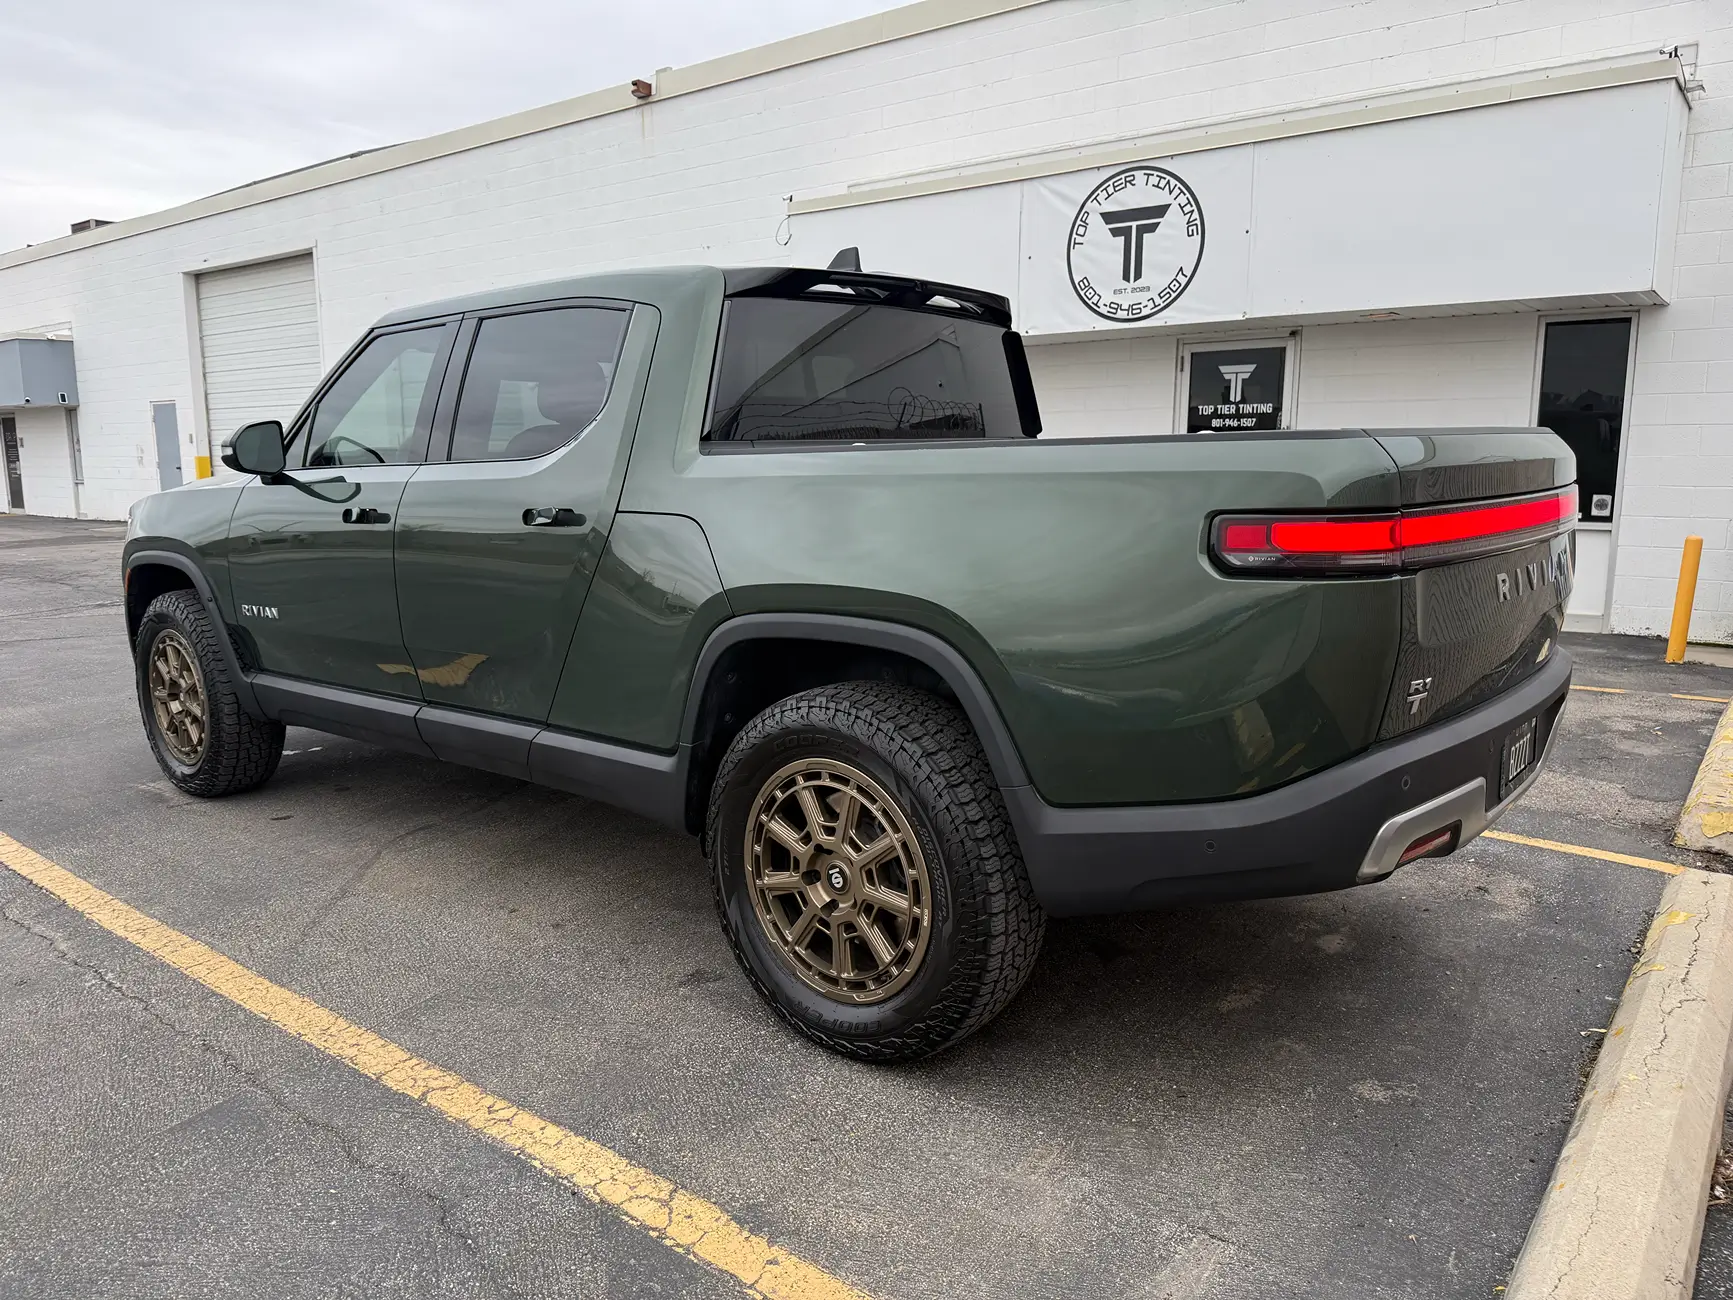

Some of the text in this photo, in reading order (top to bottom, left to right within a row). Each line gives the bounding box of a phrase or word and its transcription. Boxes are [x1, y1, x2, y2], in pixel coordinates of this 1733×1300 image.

[1072, 172, 1199, 250] TOP TIER TINTING
[1077, 266, 1188, 316] 801-946-1507
[1113, 285, 1151, 296] EST. 2023
[1198, 403, 1273, 415] TOP TIER TINTING
[1211, 418, 1257, 428] 801-946-1507
[1496, 550, 1567, 603] RIVI
[241, 604, 279, 619] RIVIAN
[1407, 691, 1428, 715] T
